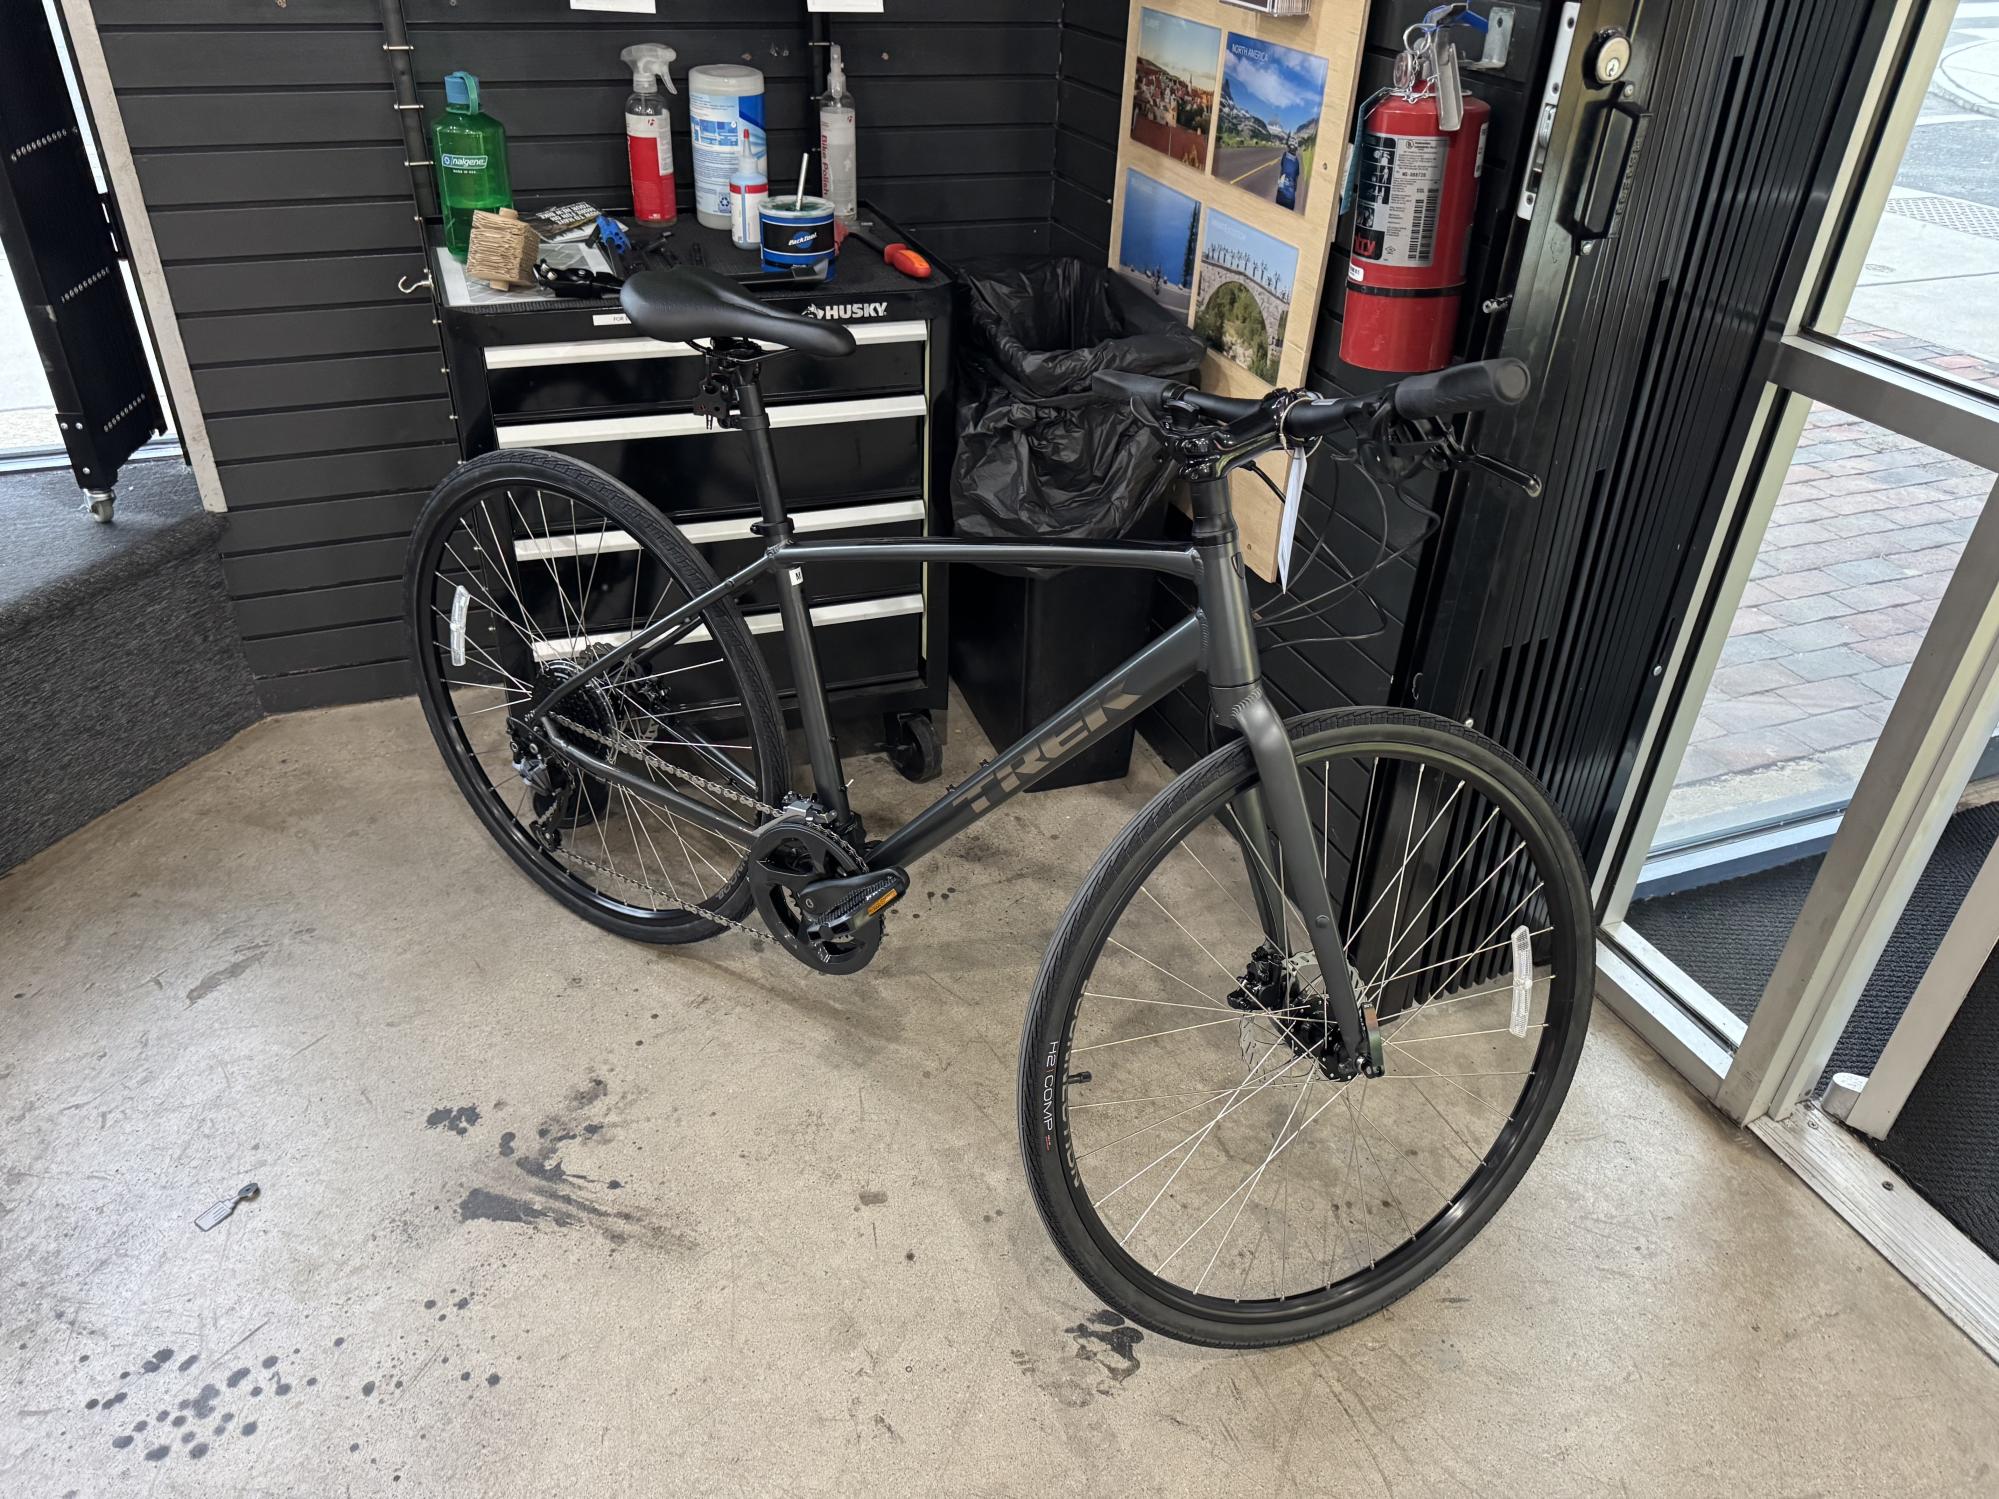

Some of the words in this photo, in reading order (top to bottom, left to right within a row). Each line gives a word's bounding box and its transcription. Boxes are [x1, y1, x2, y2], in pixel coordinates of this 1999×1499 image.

[1231, 43, 1249, 55] NORTH
[452, 157, 486, 166] nalgene
[825, 302, 888, 319] HUSKY
[952, 680, 1142, 814] TREK
[1046, 1041, 1058, 1067] H2
[1043, 1074, 1054, 1131] COMP
